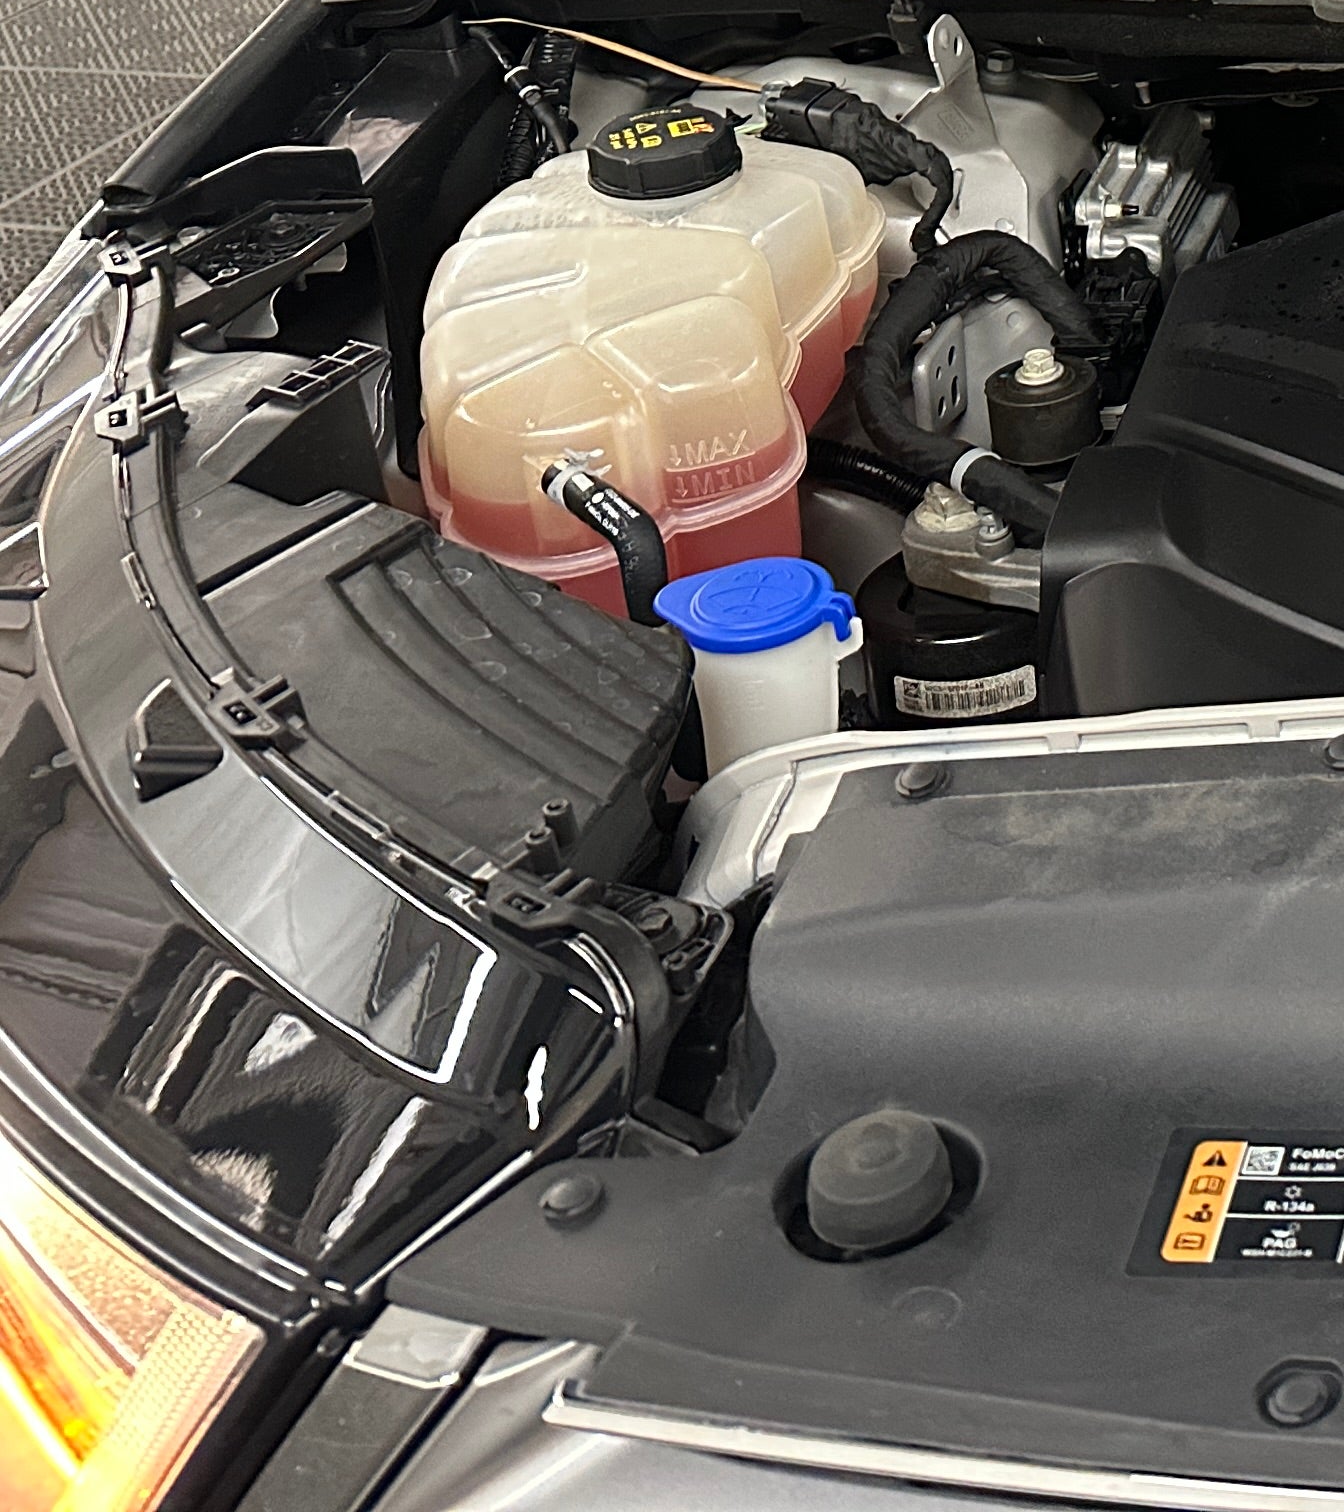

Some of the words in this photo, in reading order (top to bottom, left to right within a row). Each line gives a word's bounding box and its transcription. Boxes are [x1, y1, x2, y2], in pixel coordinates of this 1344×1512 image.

[685, 429, 751, 466] MAX
[691, 460, 756, 496] MIN
[1264, 1200, 1315, 1212] R-134a
[1262, 1237, 1297, 1249] PAG
